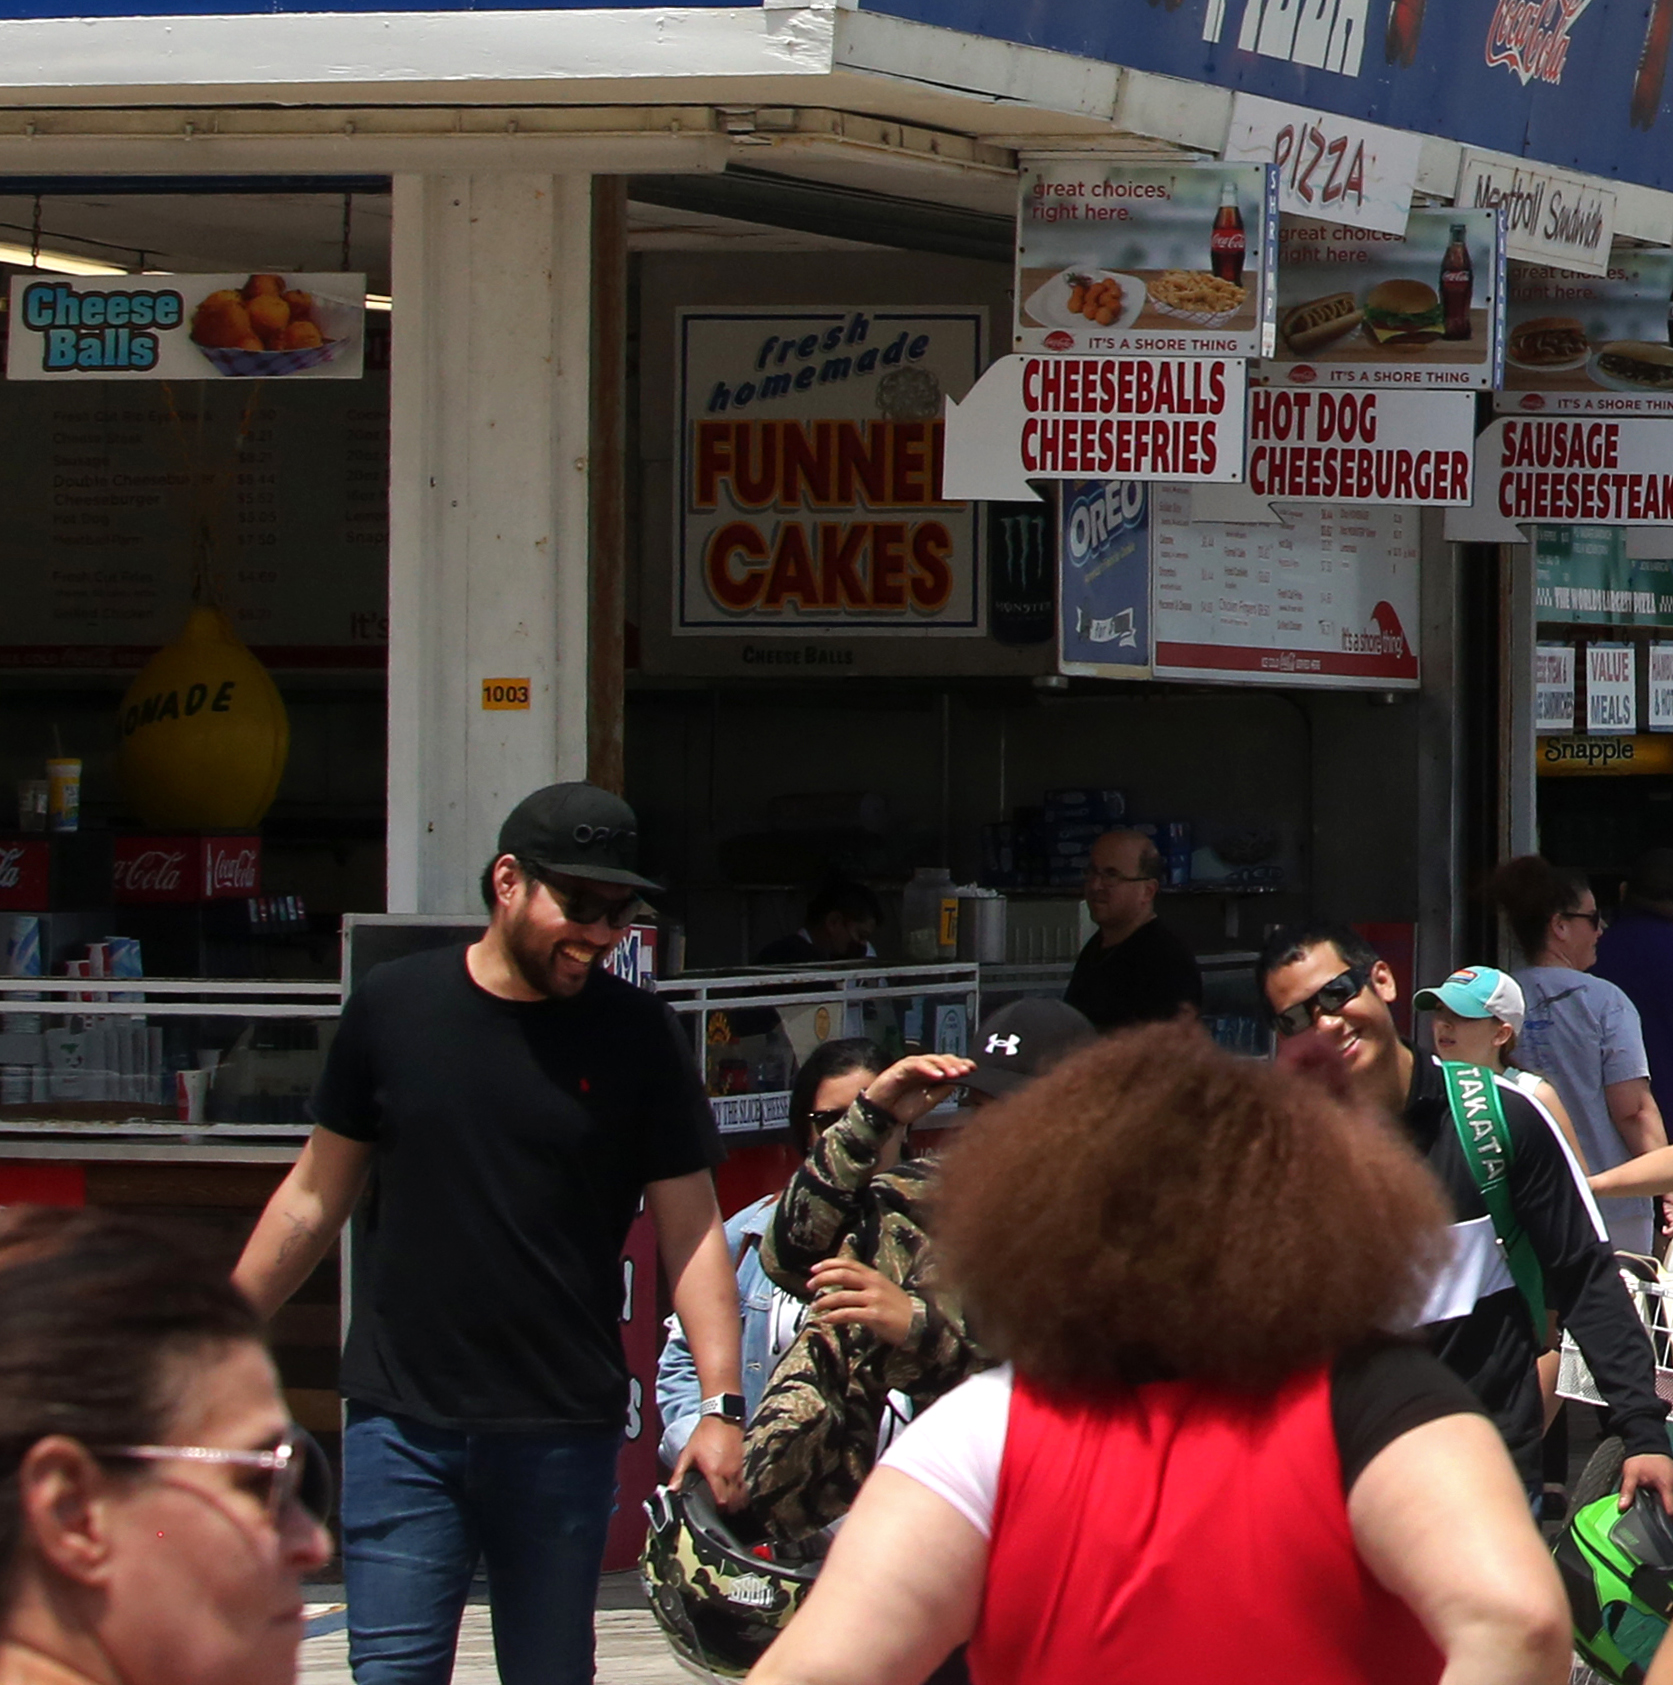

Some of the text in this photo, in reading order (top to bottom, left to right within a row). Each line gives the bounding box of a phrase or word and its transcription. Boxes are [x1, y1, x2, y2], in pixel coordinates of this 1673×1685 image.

[1275, 123, 1364, 208] PIZZA
[1032, 180, 1171, 200] great choices,
[1032, 203, 1134, 221] right here.
[1279, 227, 1325, 244] great
[24, 282, 183, 331] Cheese
[1511, 284, 1596, 301] right here.
[43, 330, 158, 371] Balls
[757, 313, 870, 369] fresh
[1089, 338, 1238, 351] IT'S A SHORE THING
[709, 331, 929, 413] homemade
[1022, 360, 1226, 415] CHEESEBALLS
[1331, 371, 1470, 383] IT'S A SHORE THING
[1251, 391, 1377, 444] HOT DOG
[1557, 399, 1580, 410] IT'S
[1584, 399, 1593, 410] A
[1597, 400, 1642, 410] SHORE
[1021, 418, 1217, 474] CHEESEFRIES
[1501, 422, 1620, 469] SAUSAGE
[1251, 446, 1469, 501] CHEESEBURGER
[1070, 480, 1143, 558] OREO
[706, 520, 953, 614] CAKES
[1591, 652, 1629, 681] VALUE
[484, 685, 529, 704] 1003
[1592, 695, 1630, 724] MEALS
[1545, 737, 1634, 765] Snapple
[1456, 1067, 1506, 1180] TAKATA
